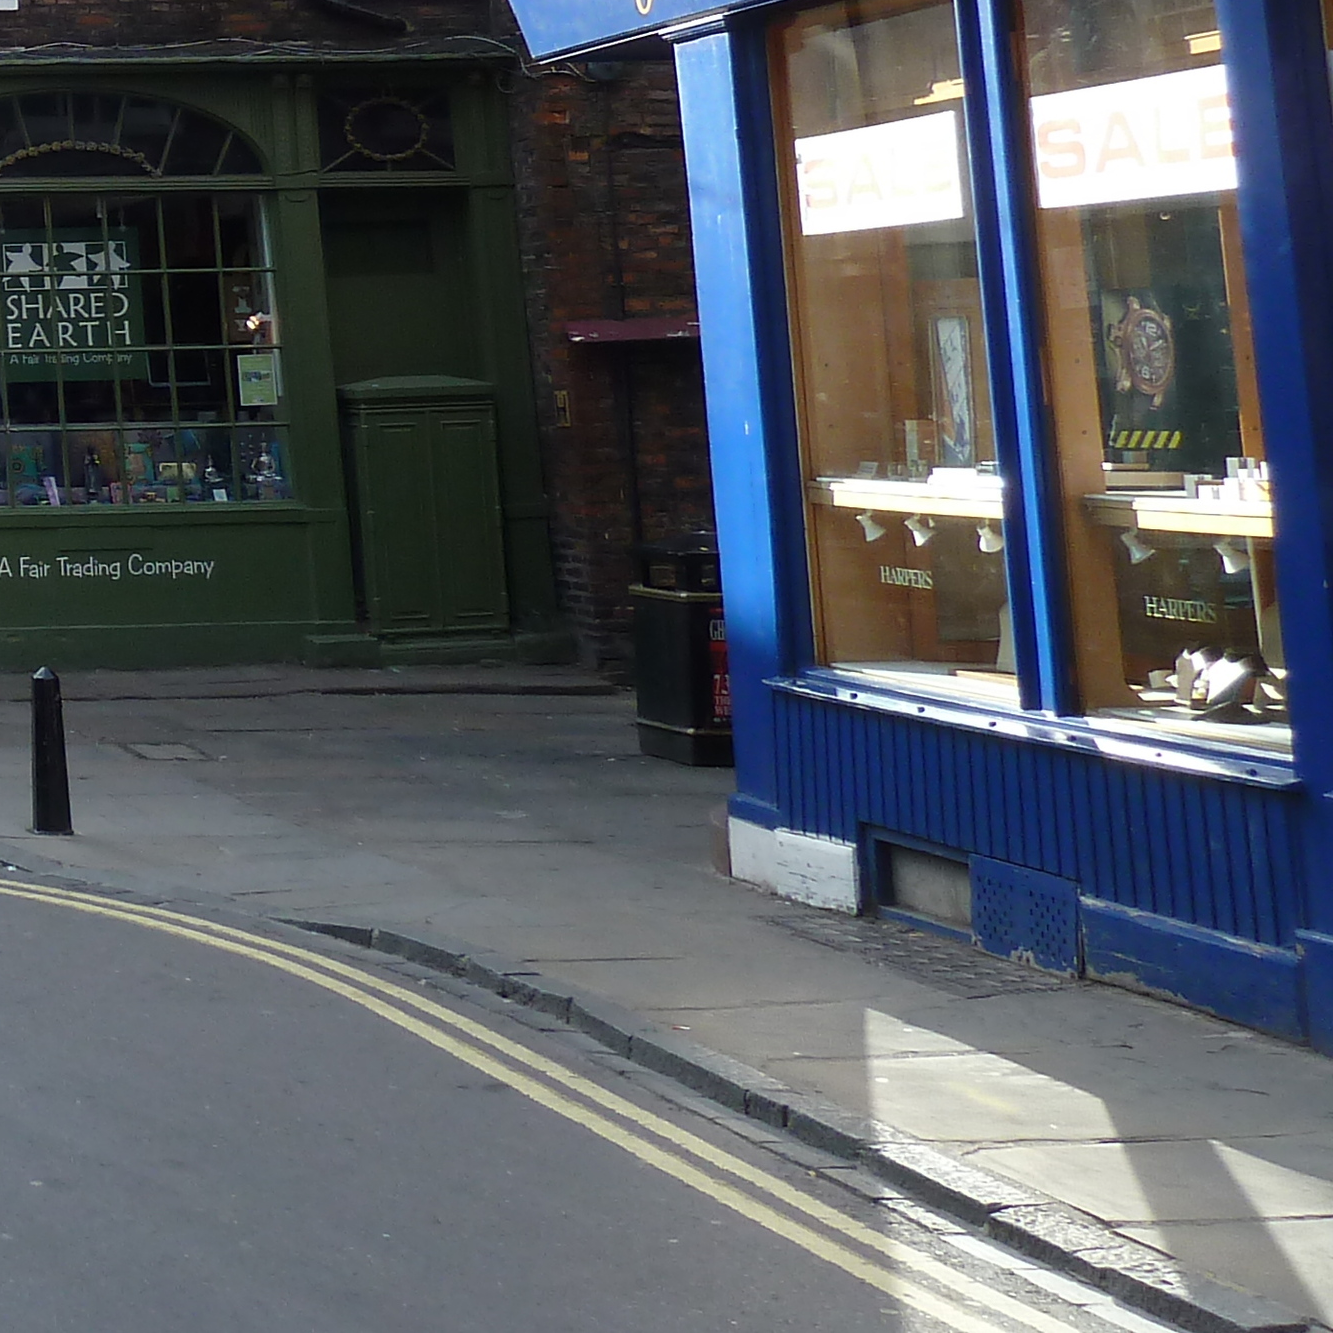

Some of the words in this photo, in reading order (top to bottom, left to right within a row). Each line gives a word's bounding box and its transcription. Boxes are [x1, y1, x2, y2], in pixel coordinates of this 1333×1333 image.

[1038, 93, 1237, 179] SALE
[6, 292, 129, 320] SHARED
[7, 320, 131, 348] EARTH
[9, 354, 19, 364] A
[44, 353, 80, 366] Traing
[83, 352, 133, 365] Compny
[19, 556, 51, 578] Fair
[56, 556, 121, 580] Trading
[128, 553, 214, 579] Company
[880, 565, 933, 590] HARPERS
[1144, 595, 1217, 624] HARPERS
